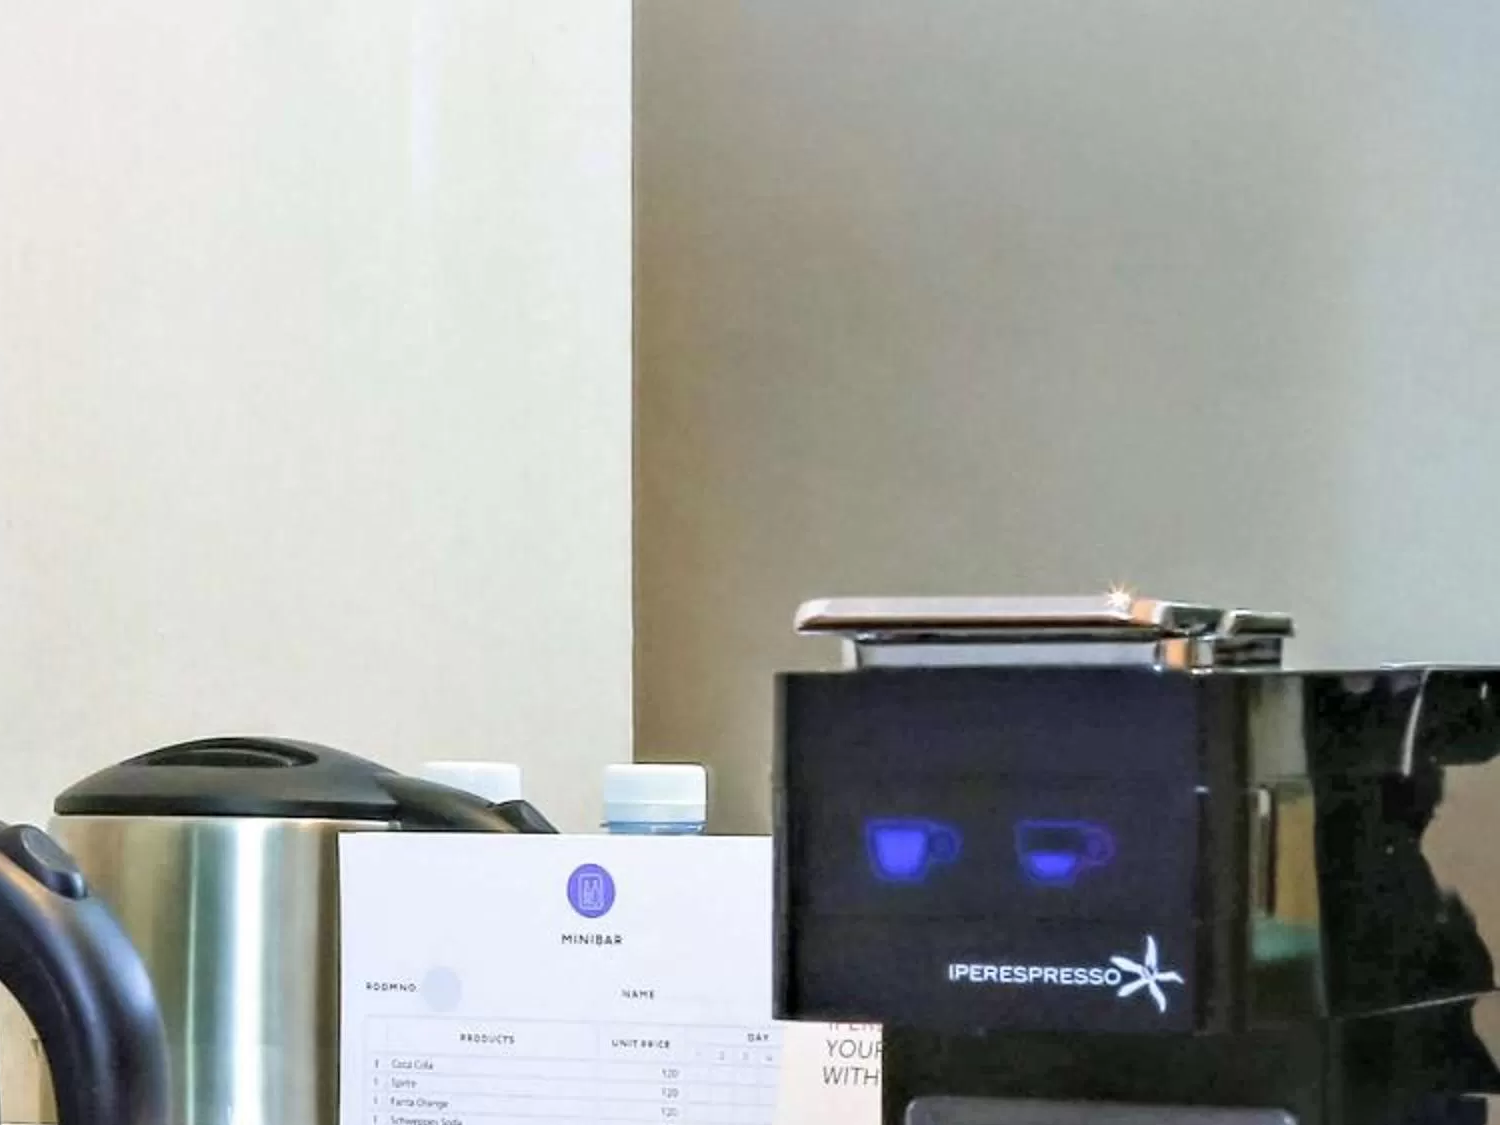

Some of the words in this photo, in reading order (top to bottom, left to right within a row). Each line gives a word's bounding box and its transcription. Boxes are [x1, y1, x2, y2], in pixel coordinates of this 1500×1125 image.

[561, 934, 623, 946] MINIBAR
[948, 962, 1122, 987] IPERESPRESSO
[622, 989, 655, 1001] NAME
[459, 1033, 516, 1045] PRODUCTS
[611, 1039, 638, 1048] UNIT
[640, 1039, 670, 1049] PRICE
[822, 1065, 879, 1086] WITH
